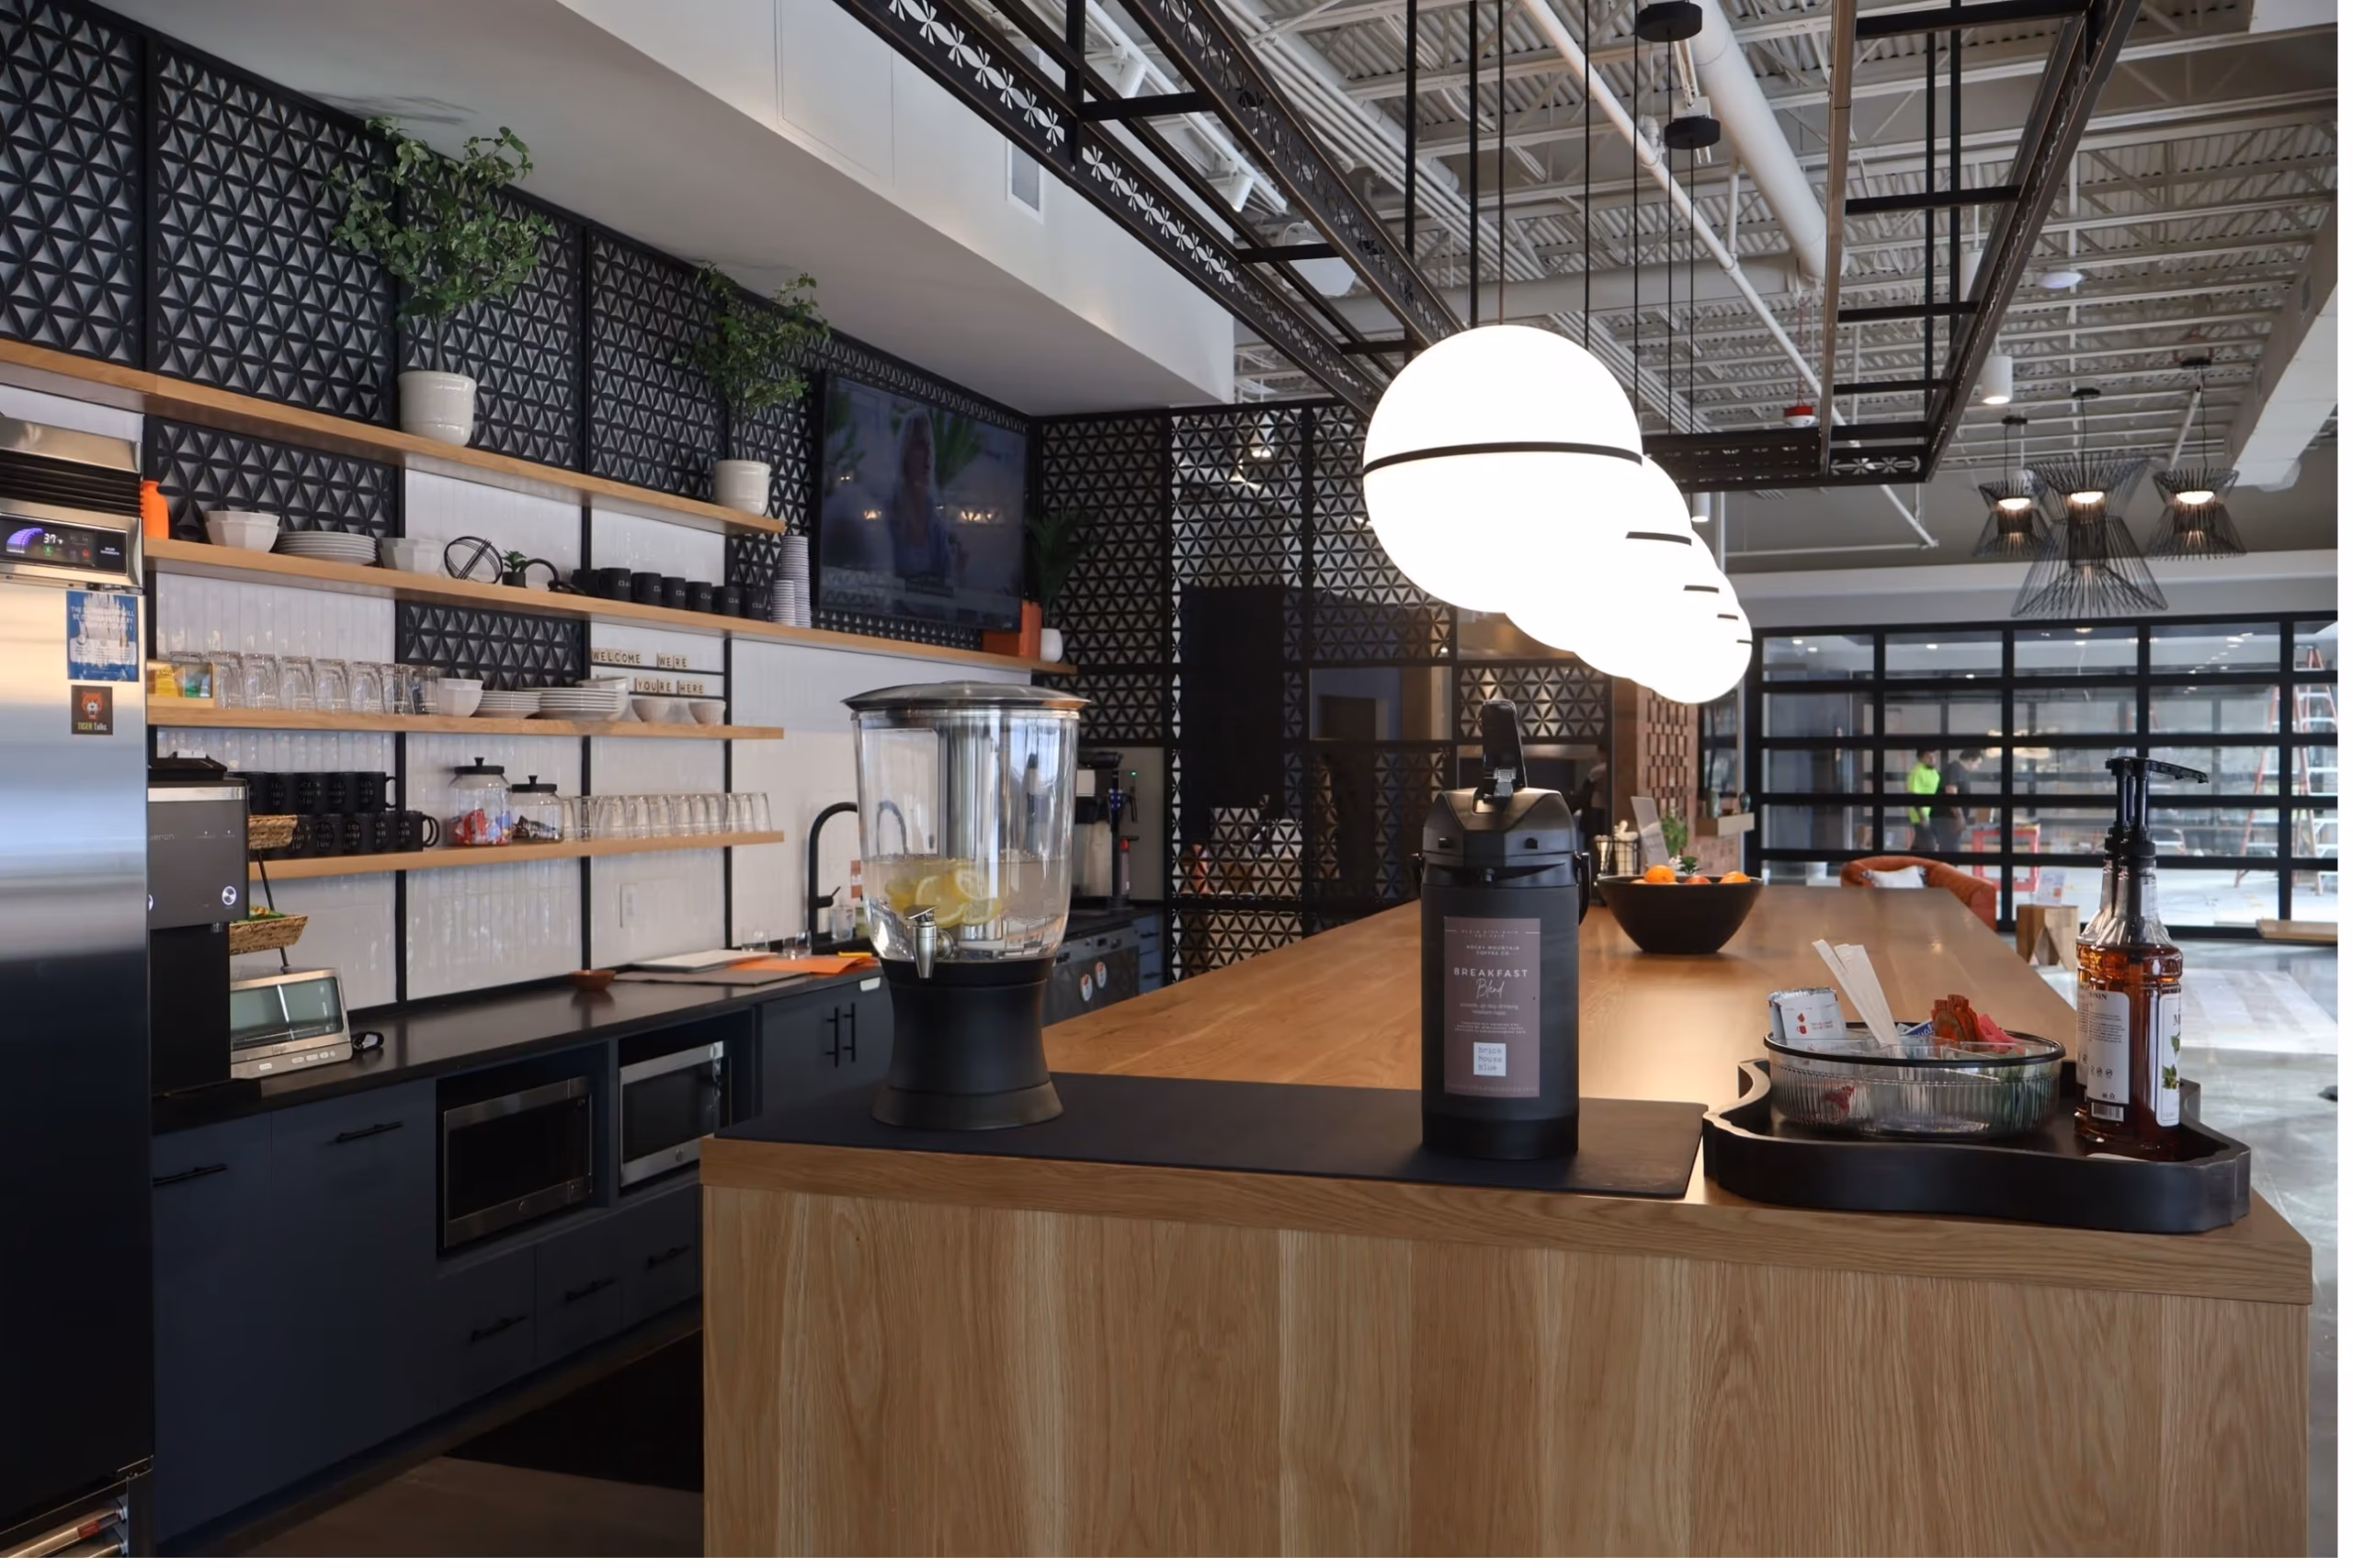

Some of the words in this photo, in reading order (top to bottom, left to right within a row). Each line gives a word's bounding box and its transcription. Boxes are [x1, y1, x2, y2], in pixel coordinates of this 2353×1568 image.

[592, 650, 642, 665] WELCOME
[679, 683, 704, 695] HERE
[1453, 967, 1529, 978] BREAKFAST
[1476, 978, 1506, 1000] Blend
[1477, 1046, 1503, 1054] brick
[1477, 1055, 1503, 1063] house
[1477, 1063, 1497, 1072] blue
